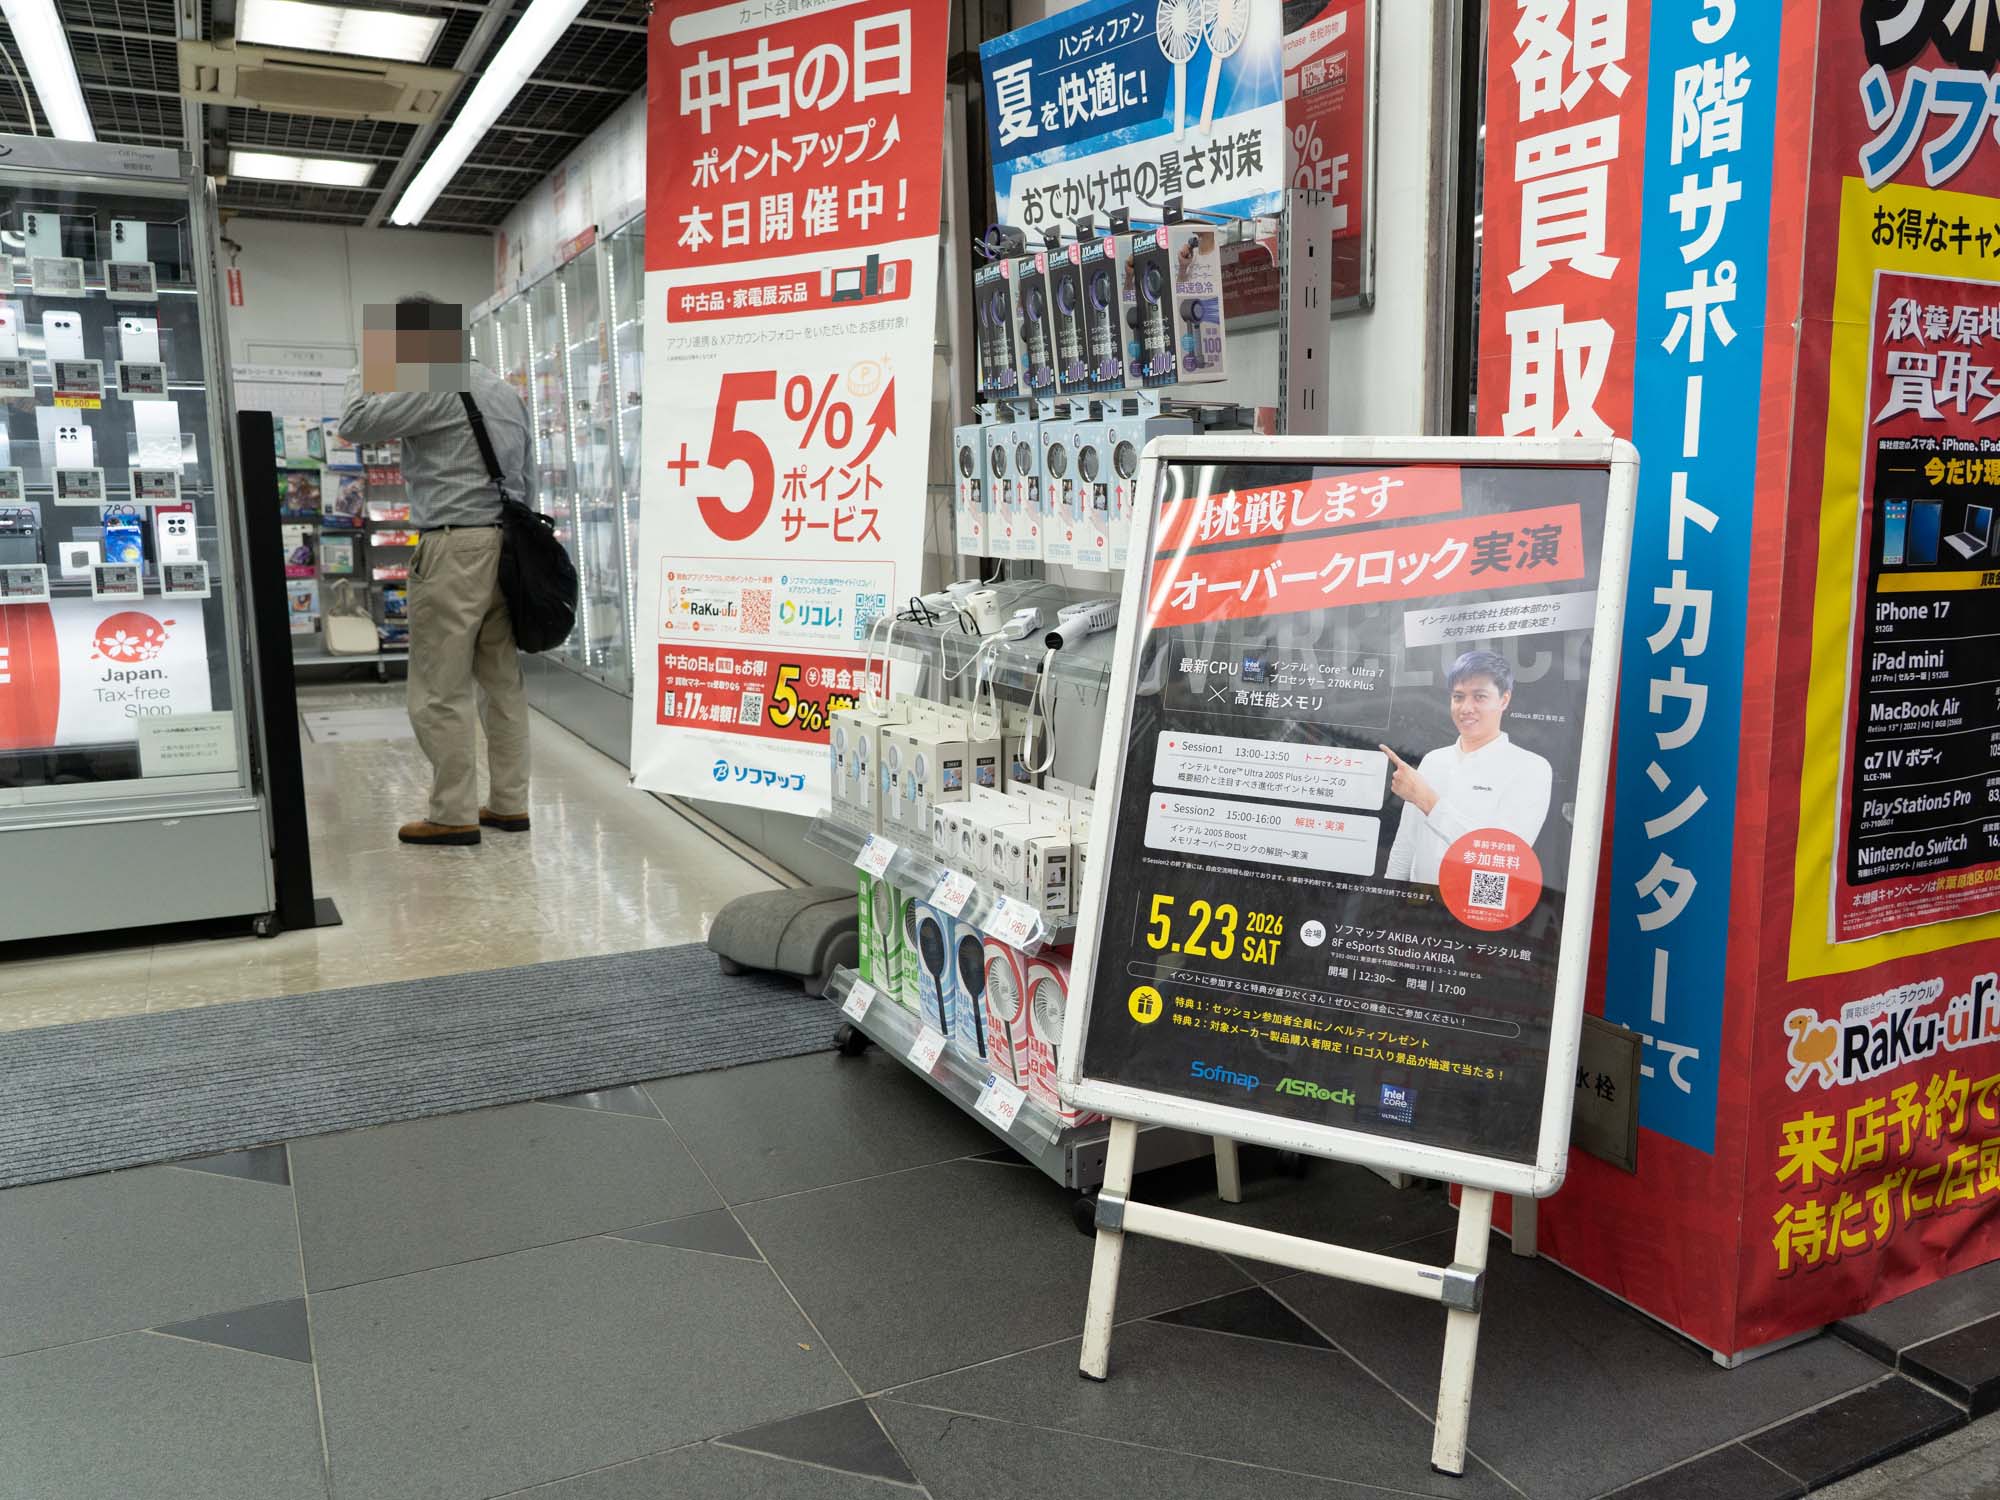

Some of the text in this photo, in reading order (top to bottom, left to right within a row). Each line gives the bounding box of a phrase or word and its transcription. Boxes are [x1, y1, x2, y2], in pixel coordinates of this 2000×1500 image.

[1058, 12, 1145, 61] ハンディファン
[680, 9, 911, 135] 中古の日
[992, 57, 1148, 148] 夏を快適に!
[691, 117, 876, 188] ポイントアップ
[1021, 128, 1263, 227] おでかけ中の暑さ対策
[678, 178, 907, 252] 本日開催中!
[681, 282, 807, 313] 中古品・家電展示品
[781, 464, 883, 502] ポイント
[1199, 476, 1404, 541] 挑戦します
[781, 505, 881, 543] サービス
[1170, 523, 1562, 611] オーバークロック実演
[800, 606, 842, 628] リコレ!
[1876, 601, 1950, 620] iPhone 17
[1179, 657, 1238, 676] 最新CPU
[1352, 666, 1376, 677] Ultra
[1378, 669, 1385, 677] 7
[1872, 649, 1944, 671] iPad mini
[101, 668, 168, 684] Japan.
[1270, 674, 1375, 691] プロセッサー 270K Plus
[94, 687, 171, 703] Tax-free
[1235, 690, 1323, 711] 高性能メモリ
[1870, 698, 1960, 721] MacBook Air
[1903, 722, 1917, 730] 2022
[1182, 741, 1363, 767] Session1 13:00-13:50 トークショー
[1887, 750, 1903, 767] IV
[1905, 747, 1942, 767] ボディ
[734, 765, 806, 791] ソフマップ
[1244, 767, 1263, 778] Ultra
[1285, 772, 1303, 782] Plus
[1304, 775, 1347, 787] シリーズの
[1863, 772, 1891, 781] ILCE-7M4
[1174, 803, 1346, 832] Session2 15:00-16:00 解説・実演
[1863, 790, 1971, 819] PlayStation5 Pro
[1171, 823, 1202, 834] インテル
[1224, 830, 1247, 841] Boost
[1463, 850, 1521, 870] 参加無料
[1858, 834, 1968, 865] Nintendo Switch
[1147, 893, 1238, 960] 5.23
[1246, 912, 1284, 935] 2026
[1304, 928, 1322, 939] 会場
[1242, 936, 1280, 966] SAT
[1331, 938, 1455, 964] 8F eSports Studio AKIBA
[1335, 924, 1531, 961] ソフマップ AKIBA パソコン・デジタル館
[1328, 965, 1349, 979] 開場
[1406, 977, 1427, 991] 閉場
[1437, 983, 1466, 996] 17:00
[1190, 1060, 1260, 1091] Sofmap
[1275, 1078, 1356, 1105] ASRock
[1384, 1088, 1405, 1100] intel
